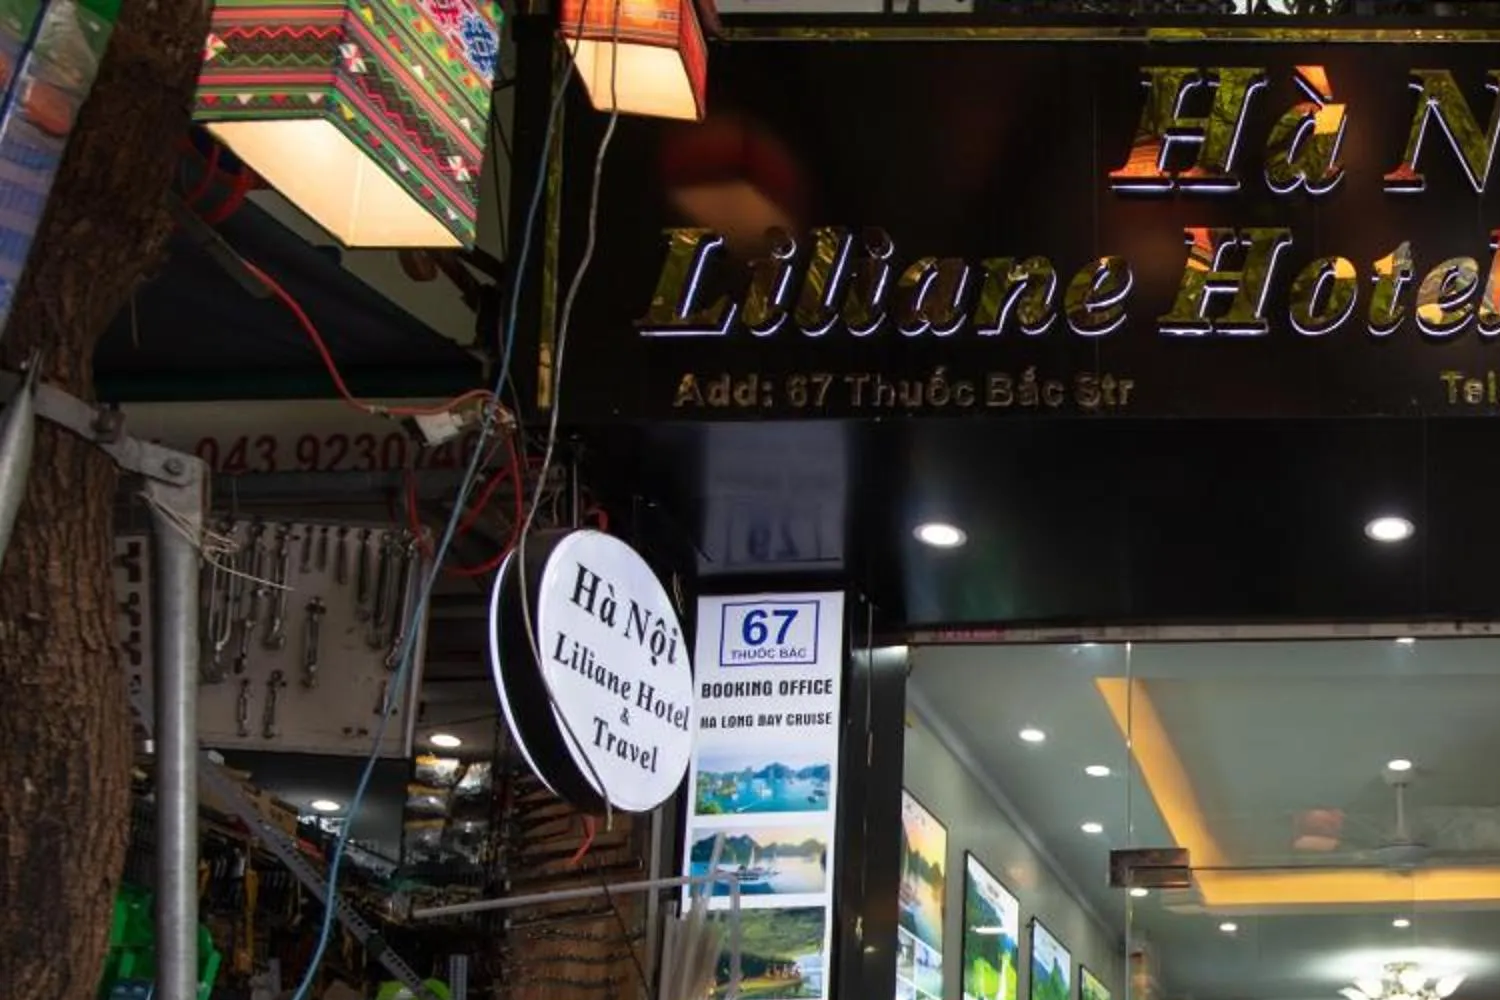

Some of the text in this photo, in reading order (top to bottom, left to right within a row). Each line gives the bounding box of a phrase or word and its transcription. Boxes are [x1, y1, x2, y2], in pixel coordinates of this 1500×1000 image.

[1109, 64, 1347, 194] Hà
[634, 226, 1133, 338] Liliane
[673, 366, 1134, 407] Add: 67 Thuốc Bắc Str
[569, 561, 680, 666] Hà Nội
[741, 609, 799, 646] 67
[552, 630, 690, 732] Liliane Hotel
[701, 679, 833, 699] BOOKING OFFICE
[619, 707, 631, 726] &
[701, 712, 832, 729] HA LONG BAY CRUISE
[592, 716, 658, 773] Travel
